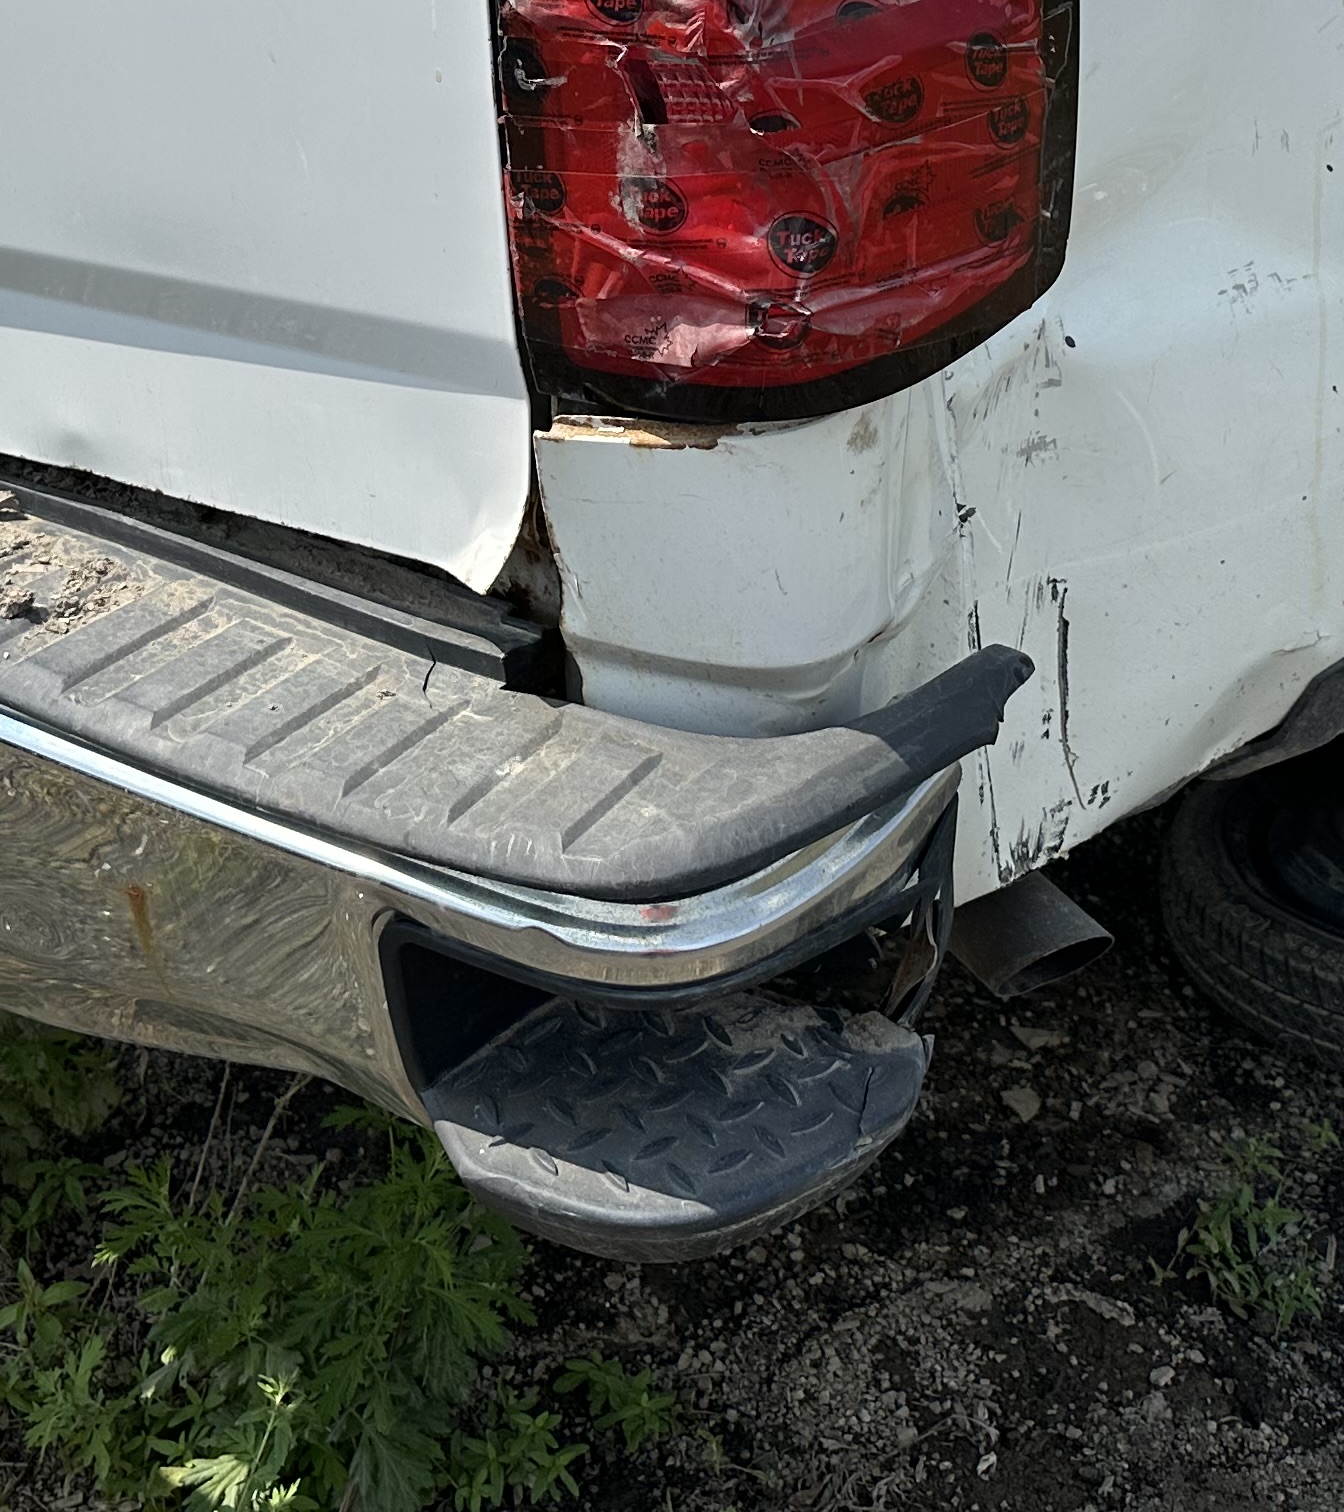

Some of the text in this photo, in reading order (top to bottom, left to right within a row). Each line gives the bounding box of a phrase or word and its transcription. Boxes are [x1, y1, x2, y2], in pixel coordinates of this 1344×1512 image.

[973, 61, 1003, 76] Tape
[758, 157, 793, 168] CCMC
[514, 171, 553, 185] Tuck
[520, 184, 560, 201] Tape
[775, 229, 826, 246] Tuck
[624, 334, 656, 346] CCMC
